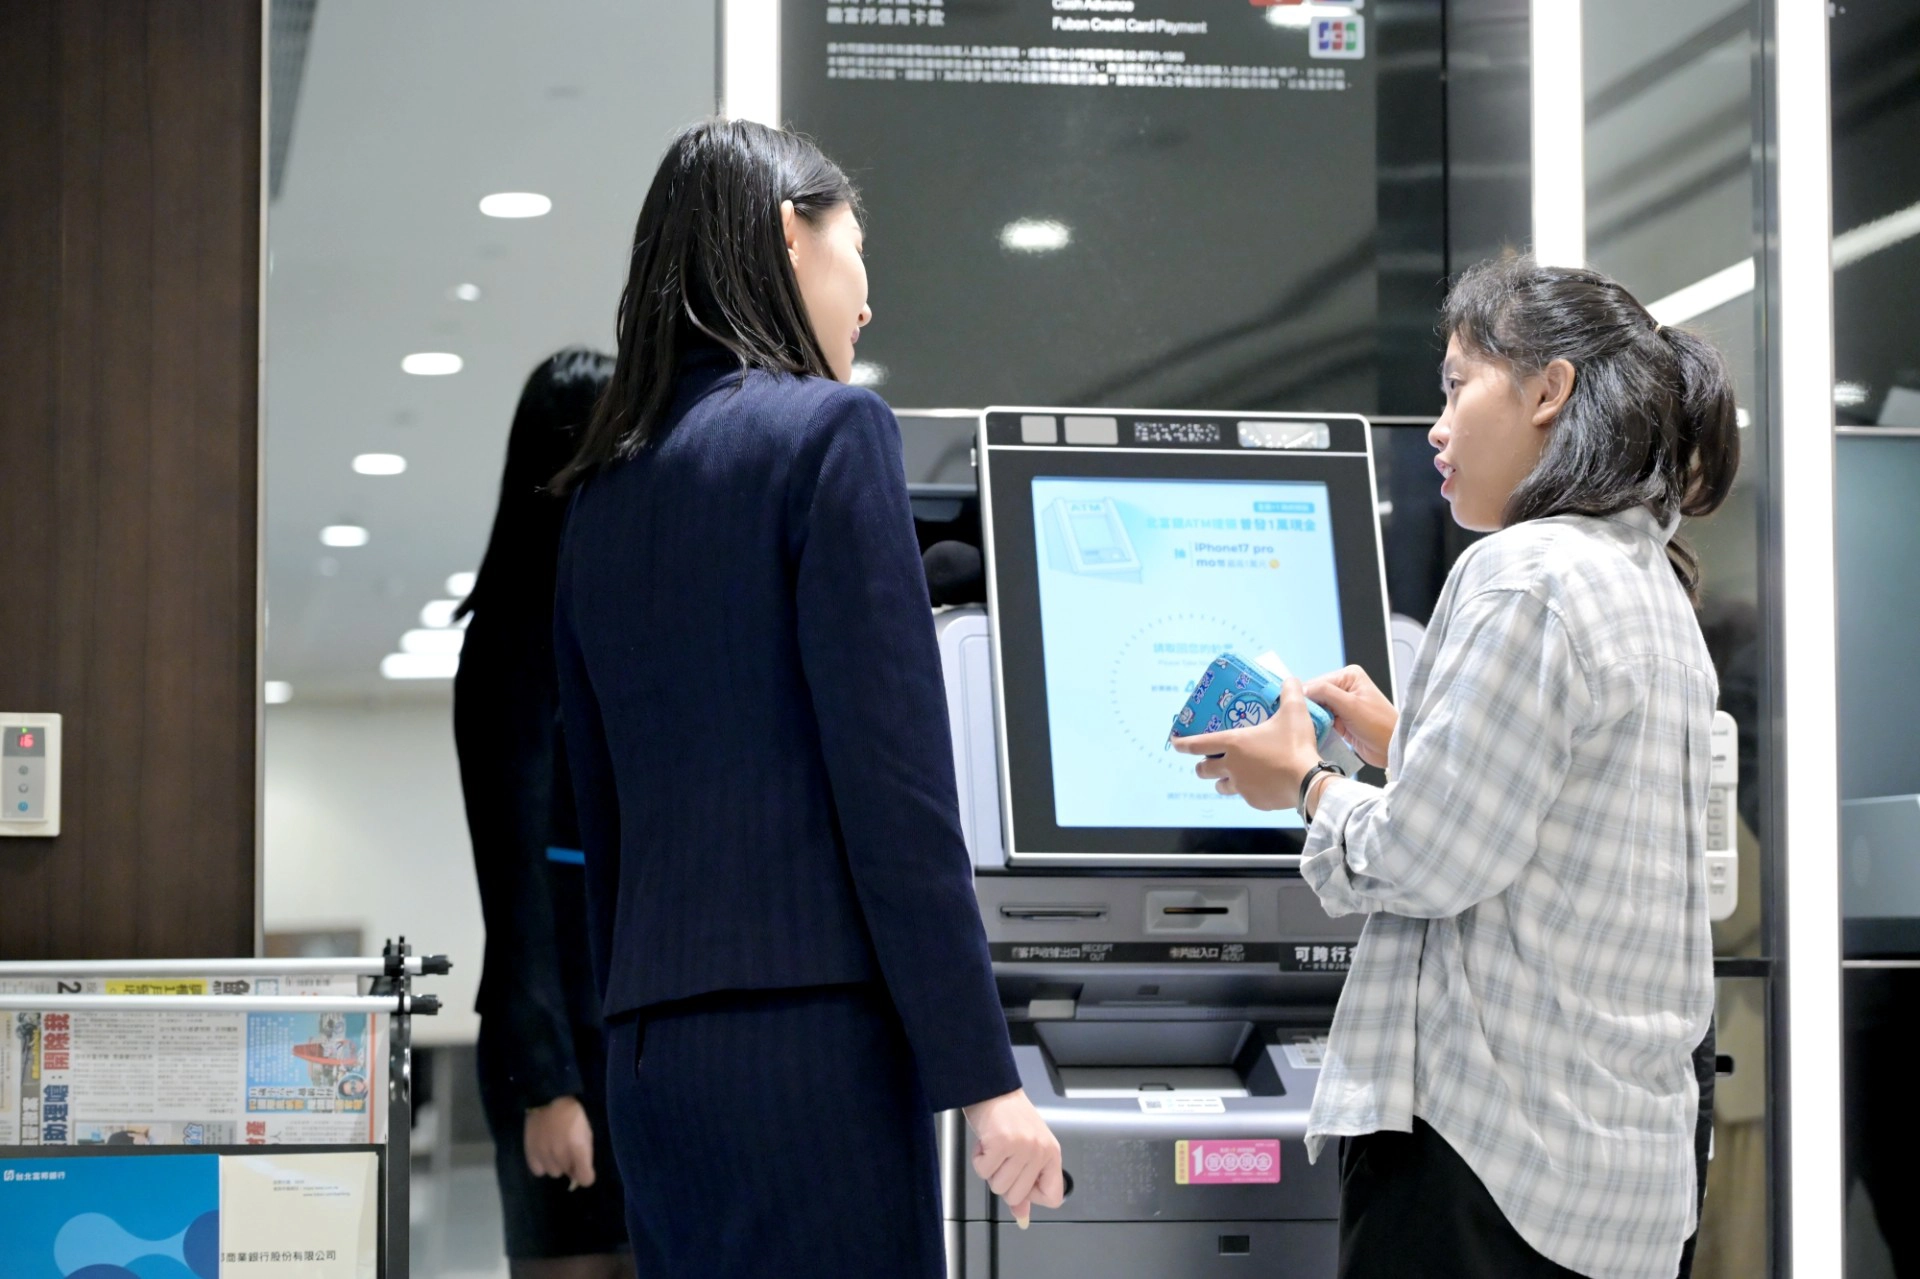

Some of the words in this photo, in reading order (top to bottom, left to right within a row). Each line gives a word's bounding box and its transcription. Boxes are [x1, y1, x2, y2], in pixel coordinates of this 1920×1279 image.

[1052, 16, 1089, 31] Fubon
[1090, 17, 1125, 32] Credit
[1126, 18, 1155, 33] Card
[1156, 19, 1207, 35] Payment
[1195, 542, 1248, 553] iPhone17
[1253, 545, 1274, 555] pro
[1081, 943, 1113, 952] RECEIPT
[1222, 944, 1244, 952] CARD
[1089, 953, 1106, 961] OUT
